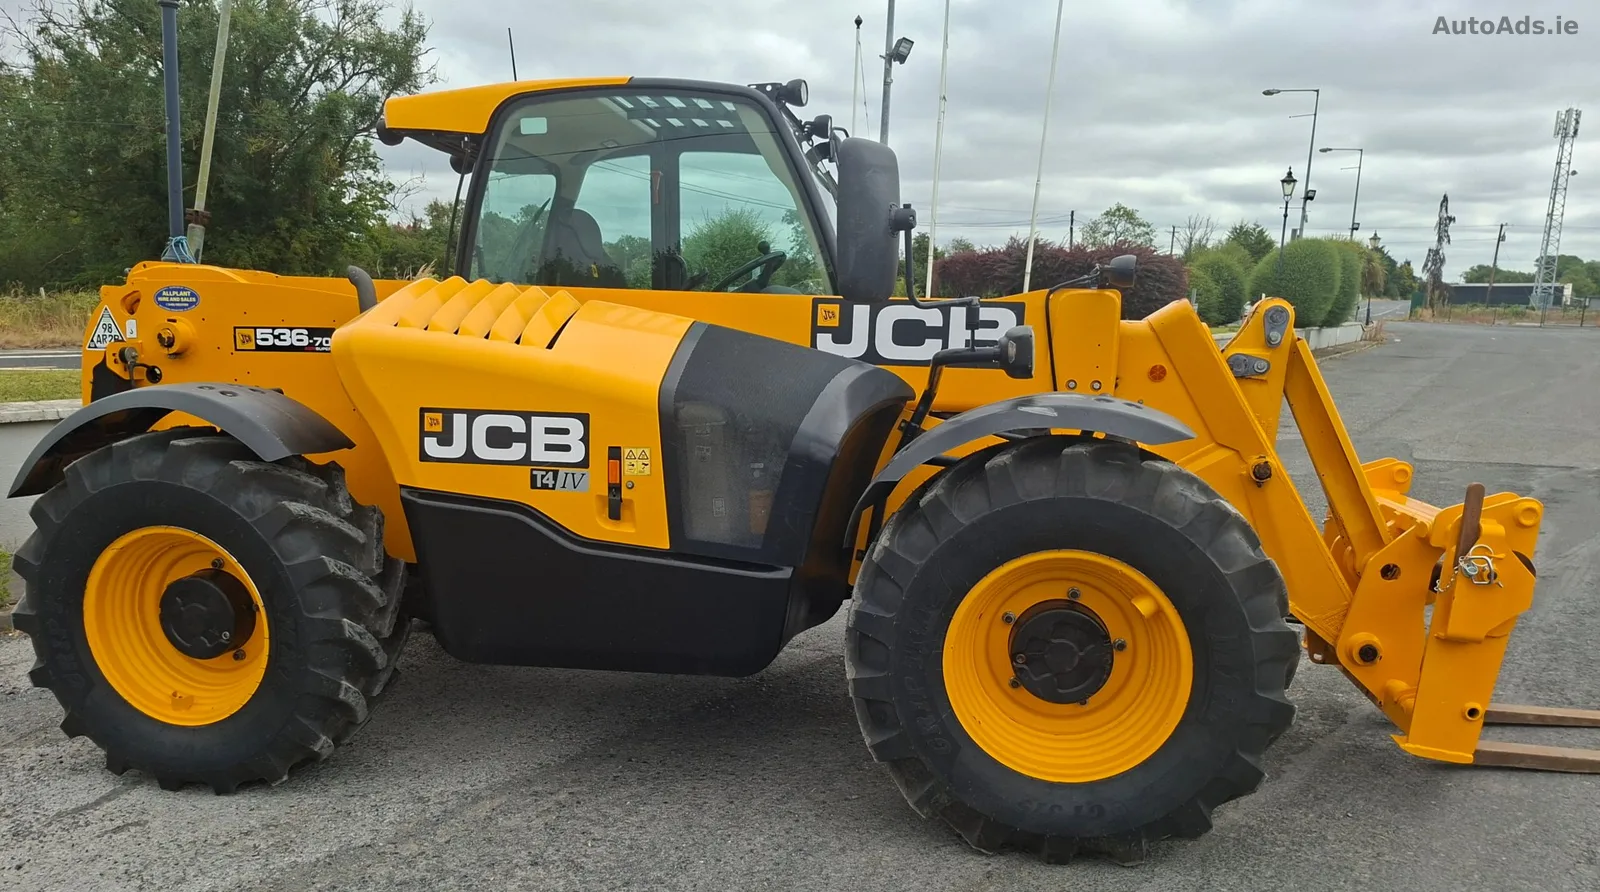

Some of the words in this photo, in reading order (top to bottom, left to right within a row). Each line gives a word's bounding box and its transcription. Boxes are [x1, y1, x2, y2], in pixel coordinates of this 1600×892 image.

[101, 323, 113, 333] 98
[256, 328, 331, 346] 536-70
[816, 304, 1017, 361] JCB
[424, 413, 586, 463] JCB
[532, 470, 555, 488] T4
[560, 472, 586, 489] IV
